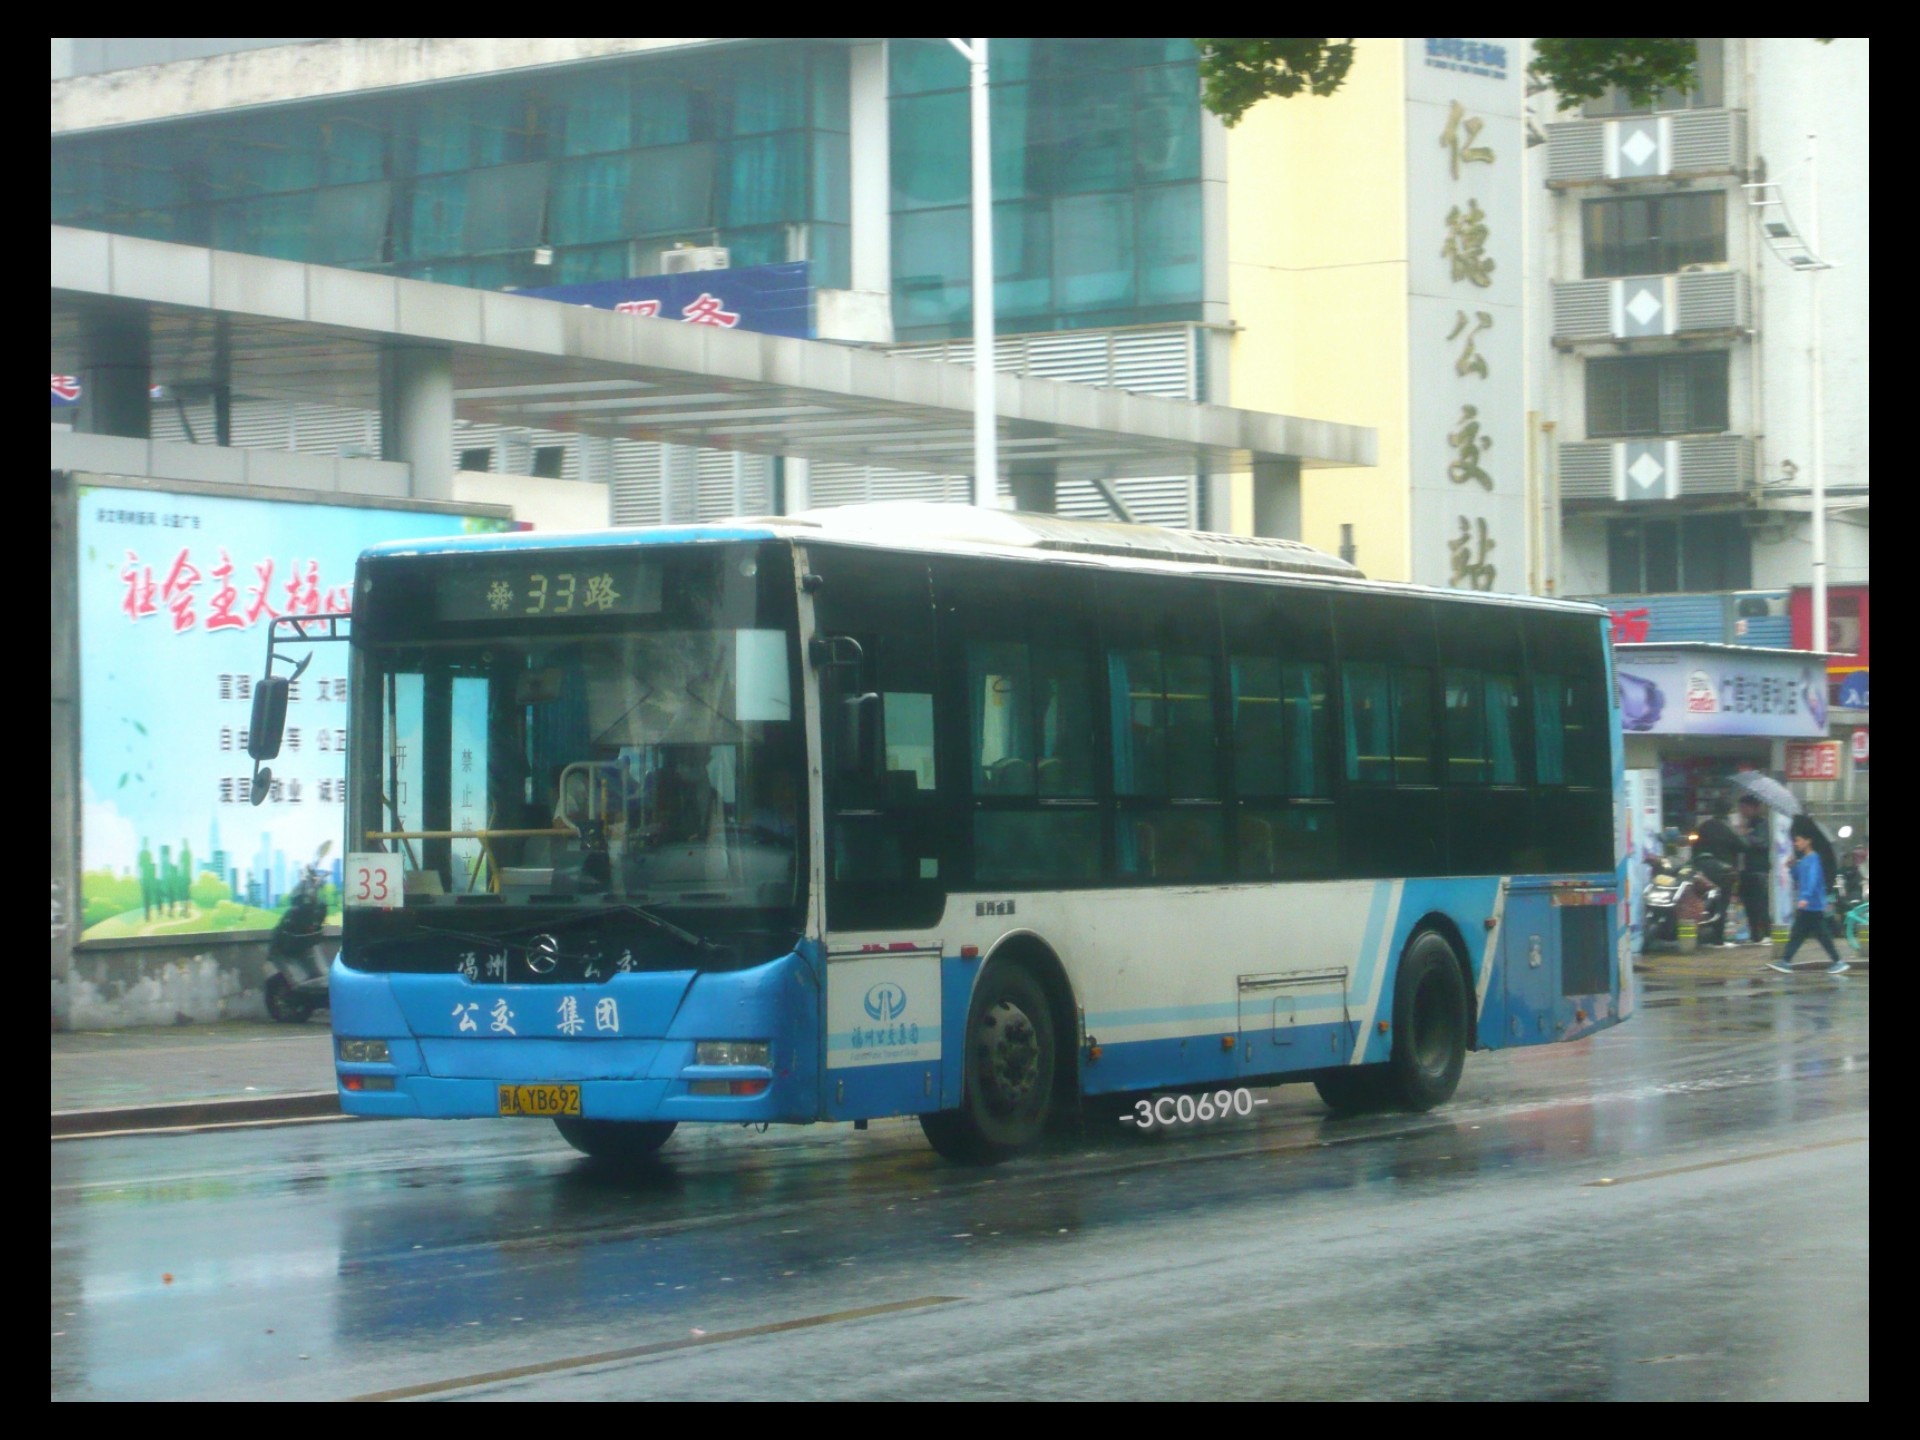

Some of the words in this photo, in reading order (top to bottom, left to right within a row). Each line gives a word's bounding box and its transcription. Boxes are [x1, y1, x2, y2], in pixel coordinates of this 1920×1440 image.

[356, 867, 388, 901] 33
[452, 999, 516, 1036] 公交
[557, 995, 620, 1036] 集团
